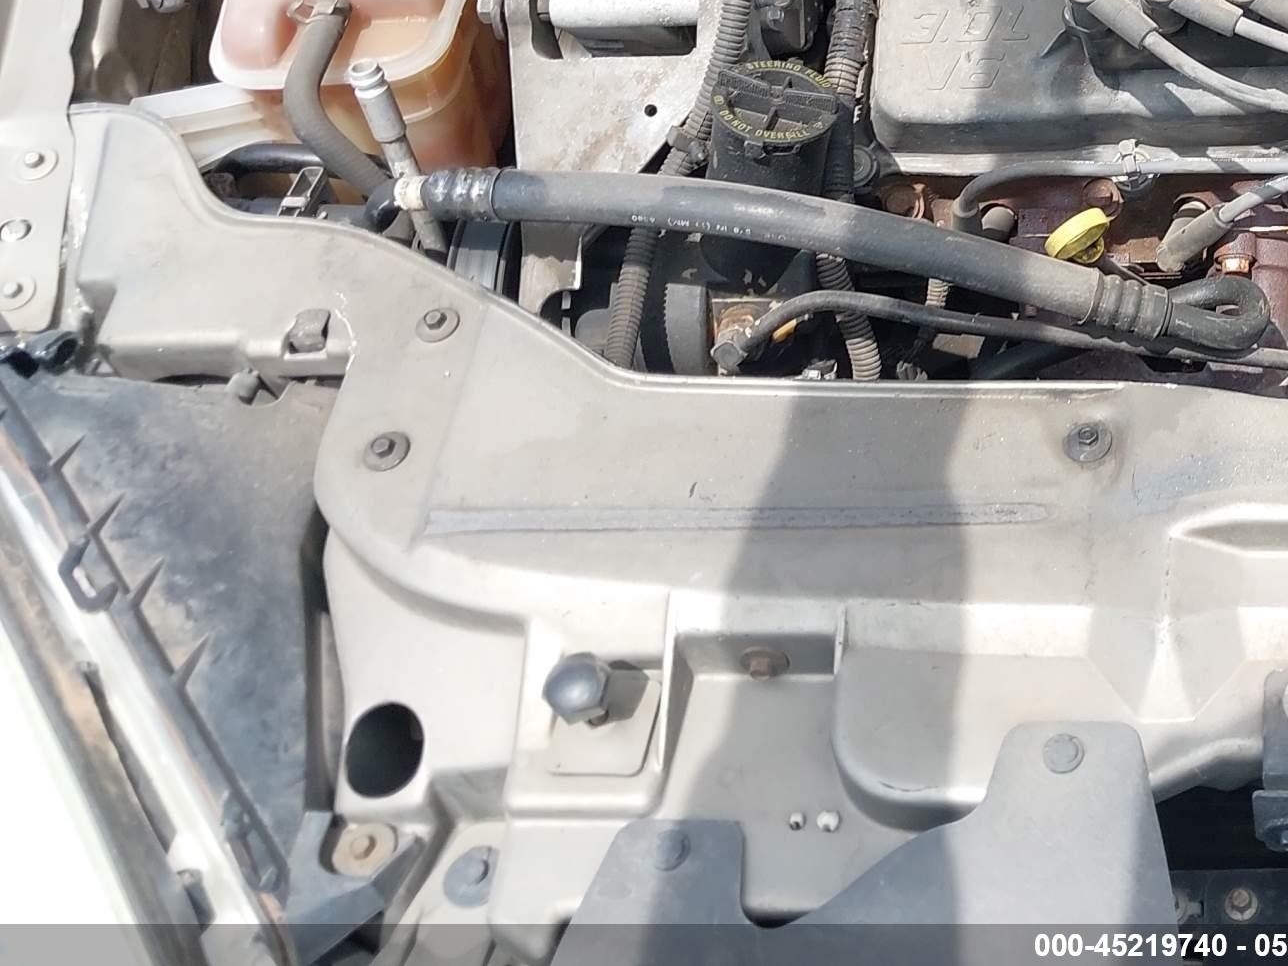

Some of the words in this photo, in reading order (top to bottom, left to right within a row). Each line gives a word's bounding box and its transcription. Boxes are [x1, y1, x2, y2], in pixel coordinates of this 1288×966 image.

[899, 6, 1030, 45] 3.0L
[926, 50, 1007, 91] V6
[730, 119, 753, 133] NOT
